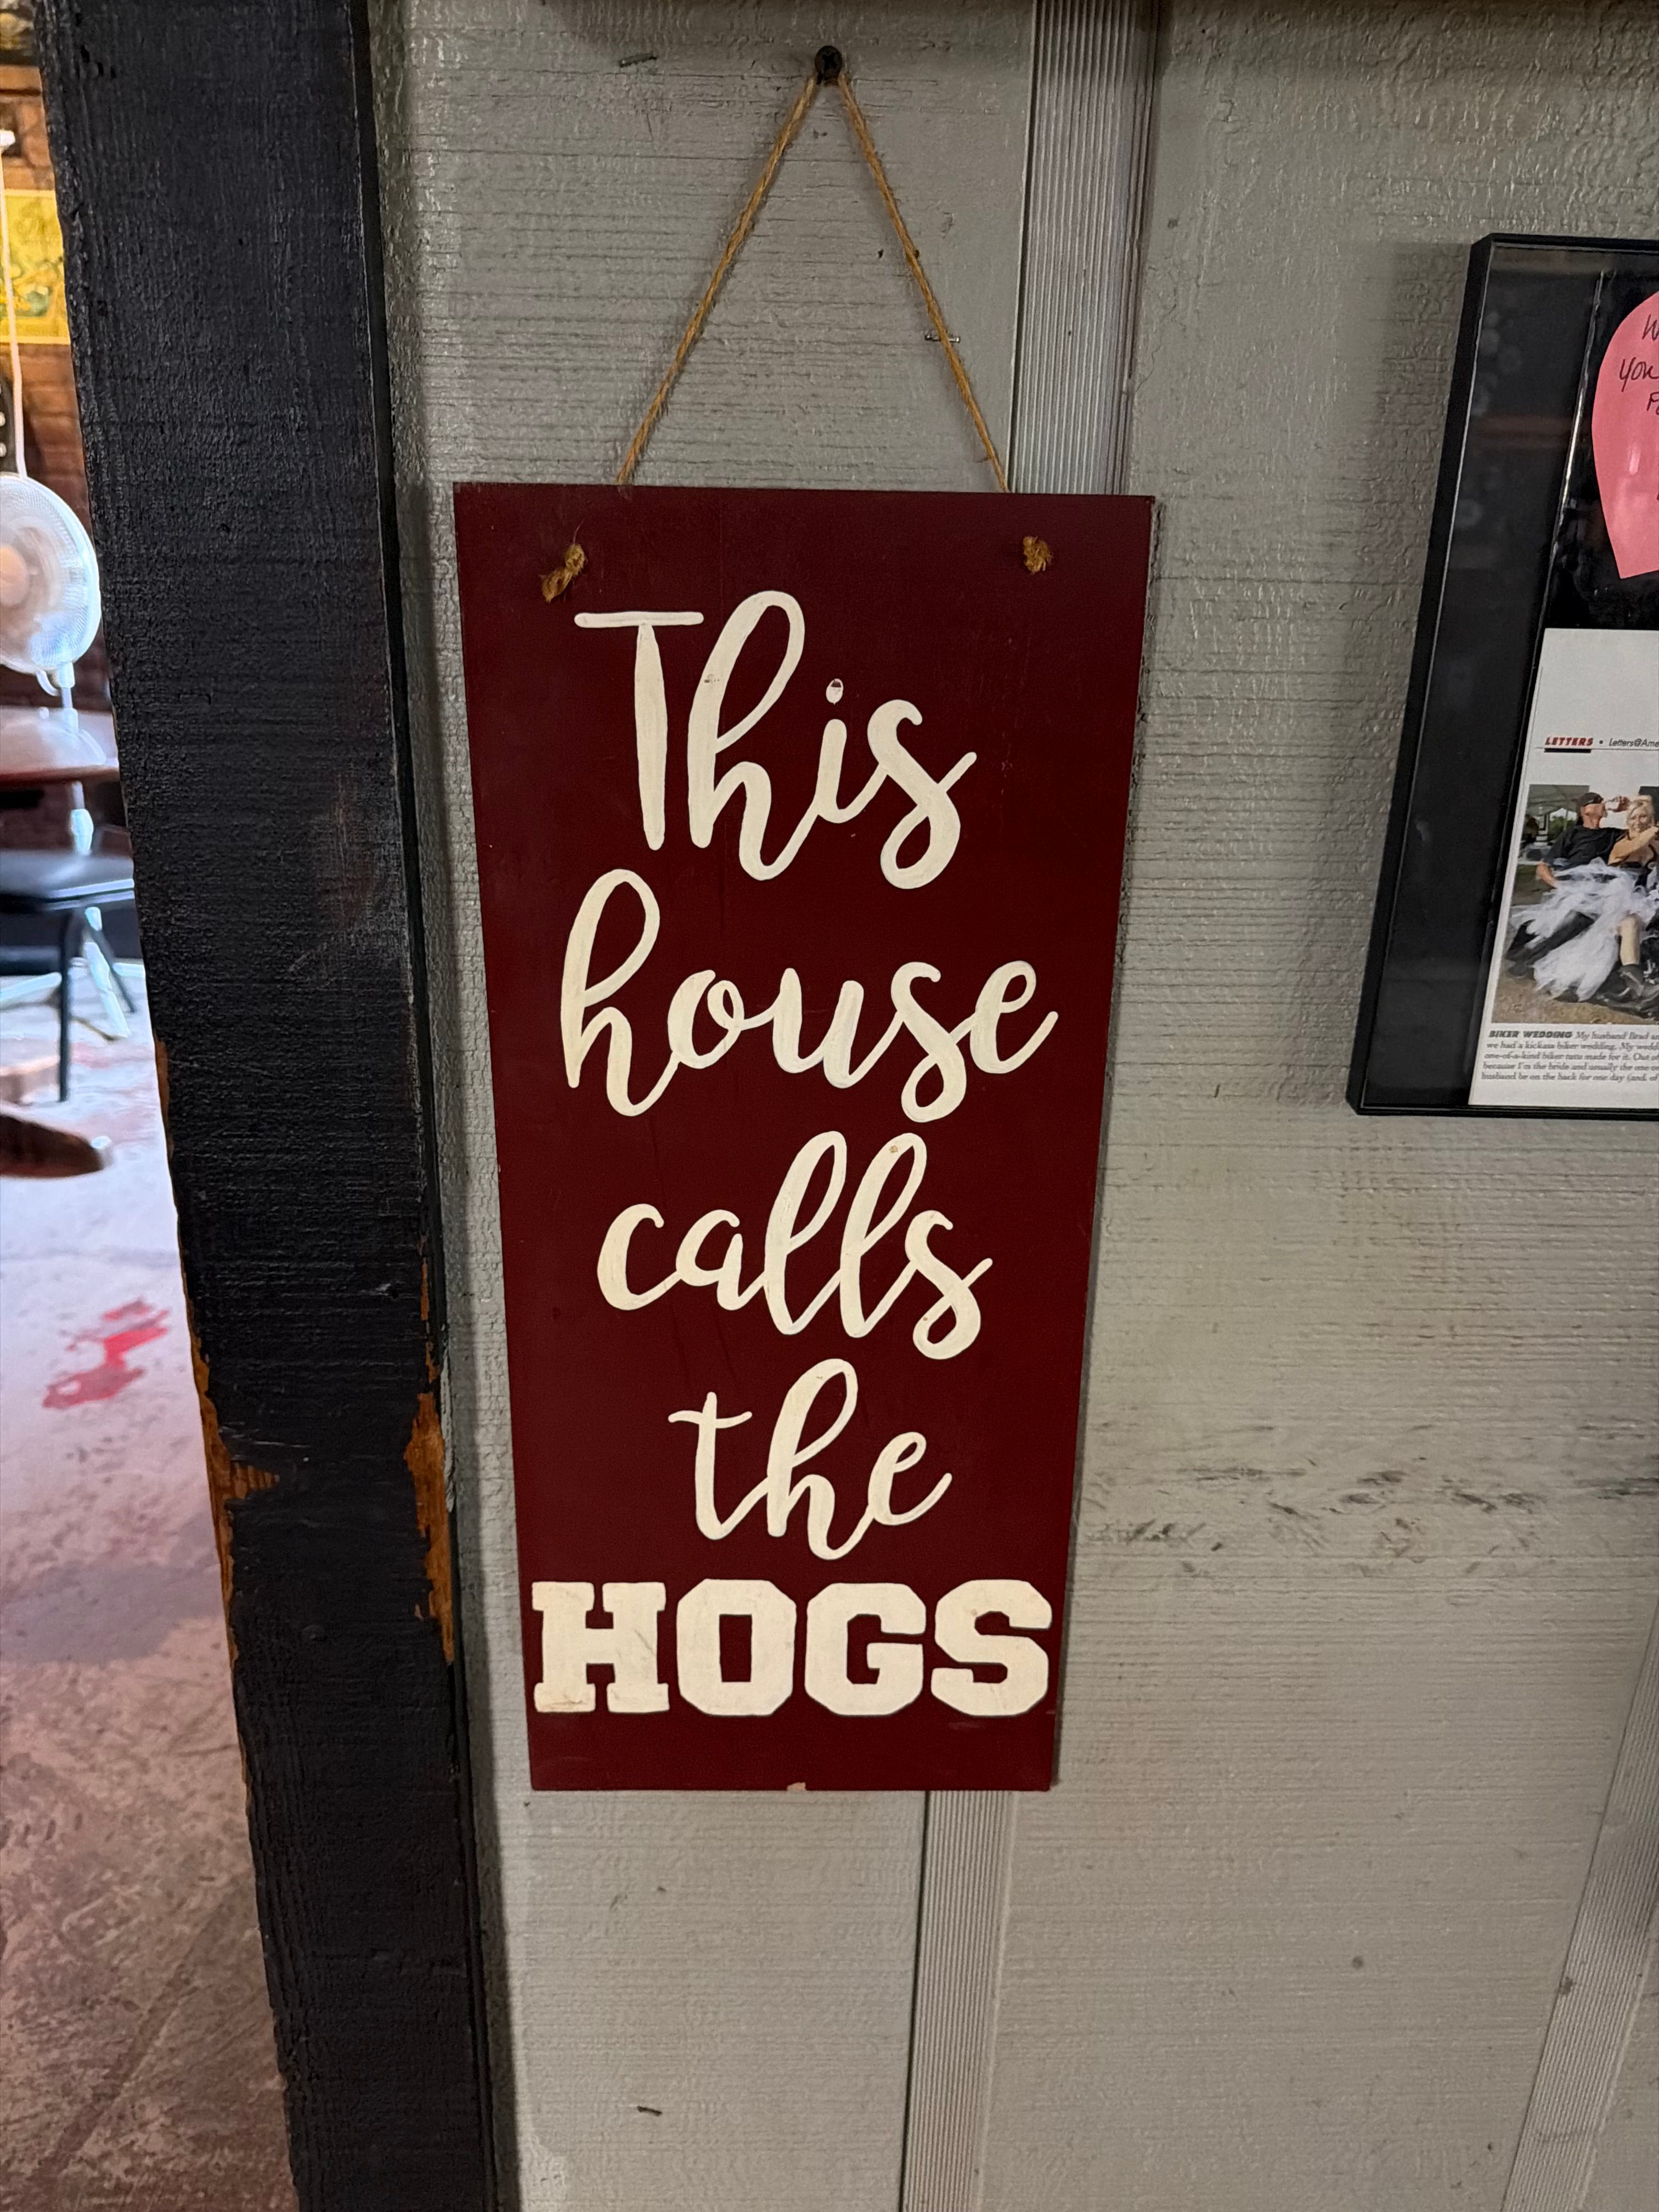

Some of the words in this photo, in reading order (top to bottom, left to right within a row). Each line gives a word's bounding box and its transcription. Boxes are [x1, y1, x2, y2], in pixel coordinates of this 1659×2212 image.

[574, 591, 977, 889] This
[1545, 736, 1594, 746] LETTERS
[561, 869, 1058, 1122] house
[1483, 1061, 1516, 1070] because
[1533, 1062, 1547, 1070] the
[1548, 1062, 1570, 1070] bride
[1571, 1062, 1587, 1070] and
[1620, 1062, 1633, 1071] the
[1523, 1030, 1572, 1039] WEDDING
[1574, 1031, 1589, 1041] My
[1592, 1031, 1627, 1040] husband
[1557, 1041, 1579, 1049] biker
[1481, 1071, 1516, 1080] husband
[1542, 1072, 1555, 1080] the
[597, 1131, 992, 1359] calls
[668, 1359, 952, 1560] the
[532, 1579, 1052, 1716] HOGS
